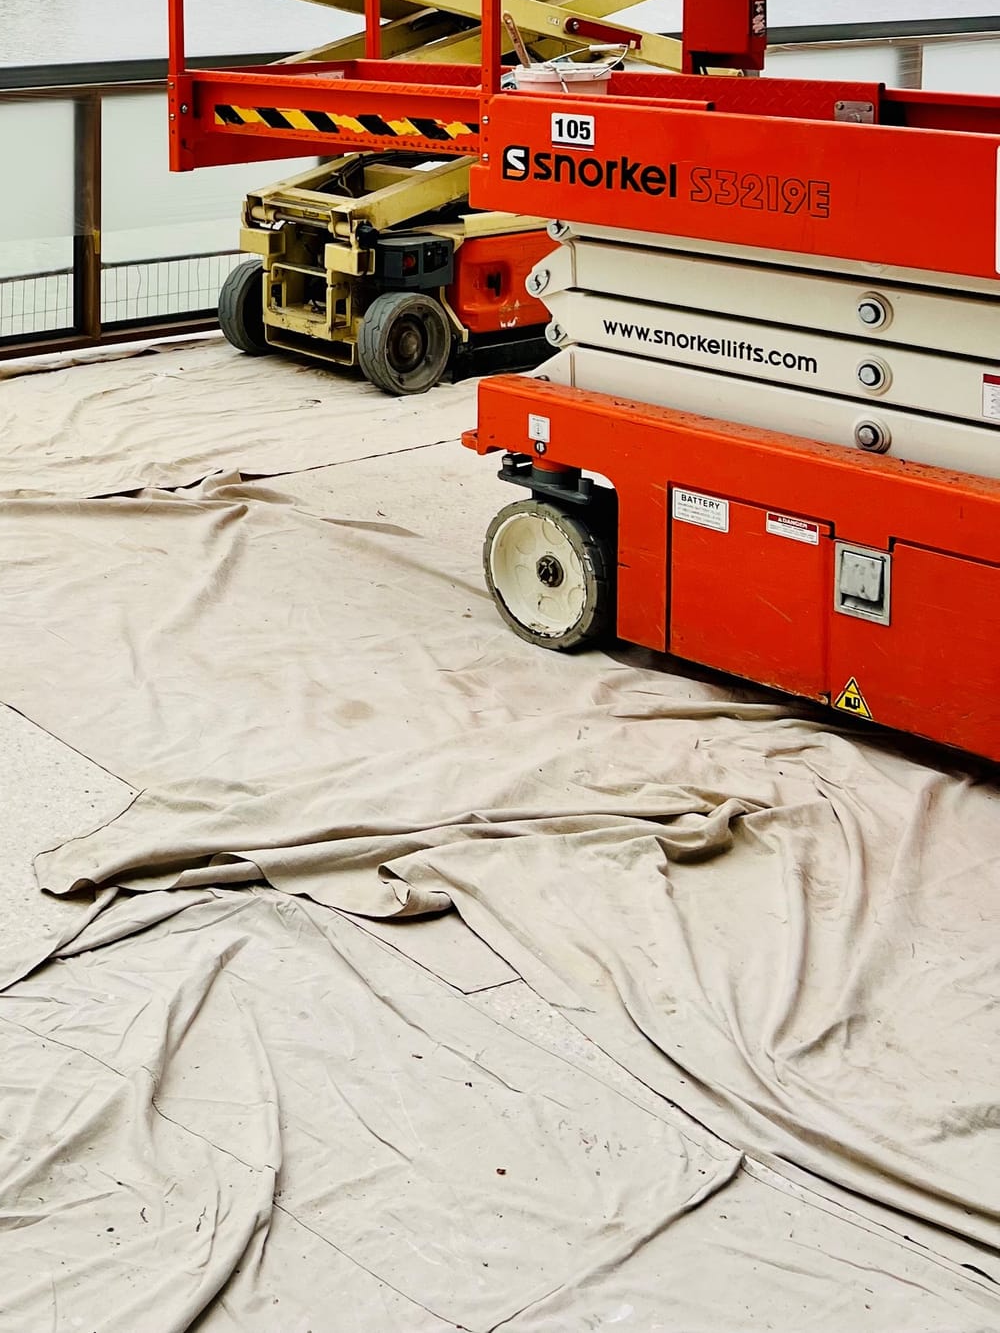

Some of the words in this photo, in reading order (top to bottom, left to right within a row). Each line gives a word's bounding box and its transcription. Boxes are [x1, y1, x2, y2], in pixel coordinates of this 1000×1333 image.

[554, 118, 592, 141] 105
[533, 151, 678, 199] snorkel
[689, 166, 831, 219] S3219E
[602, 319, 818, 374] www.snorkellifts.com
[680, 493, 721, 511] BATTERY
[781, 516, 809, 530] DANGER
